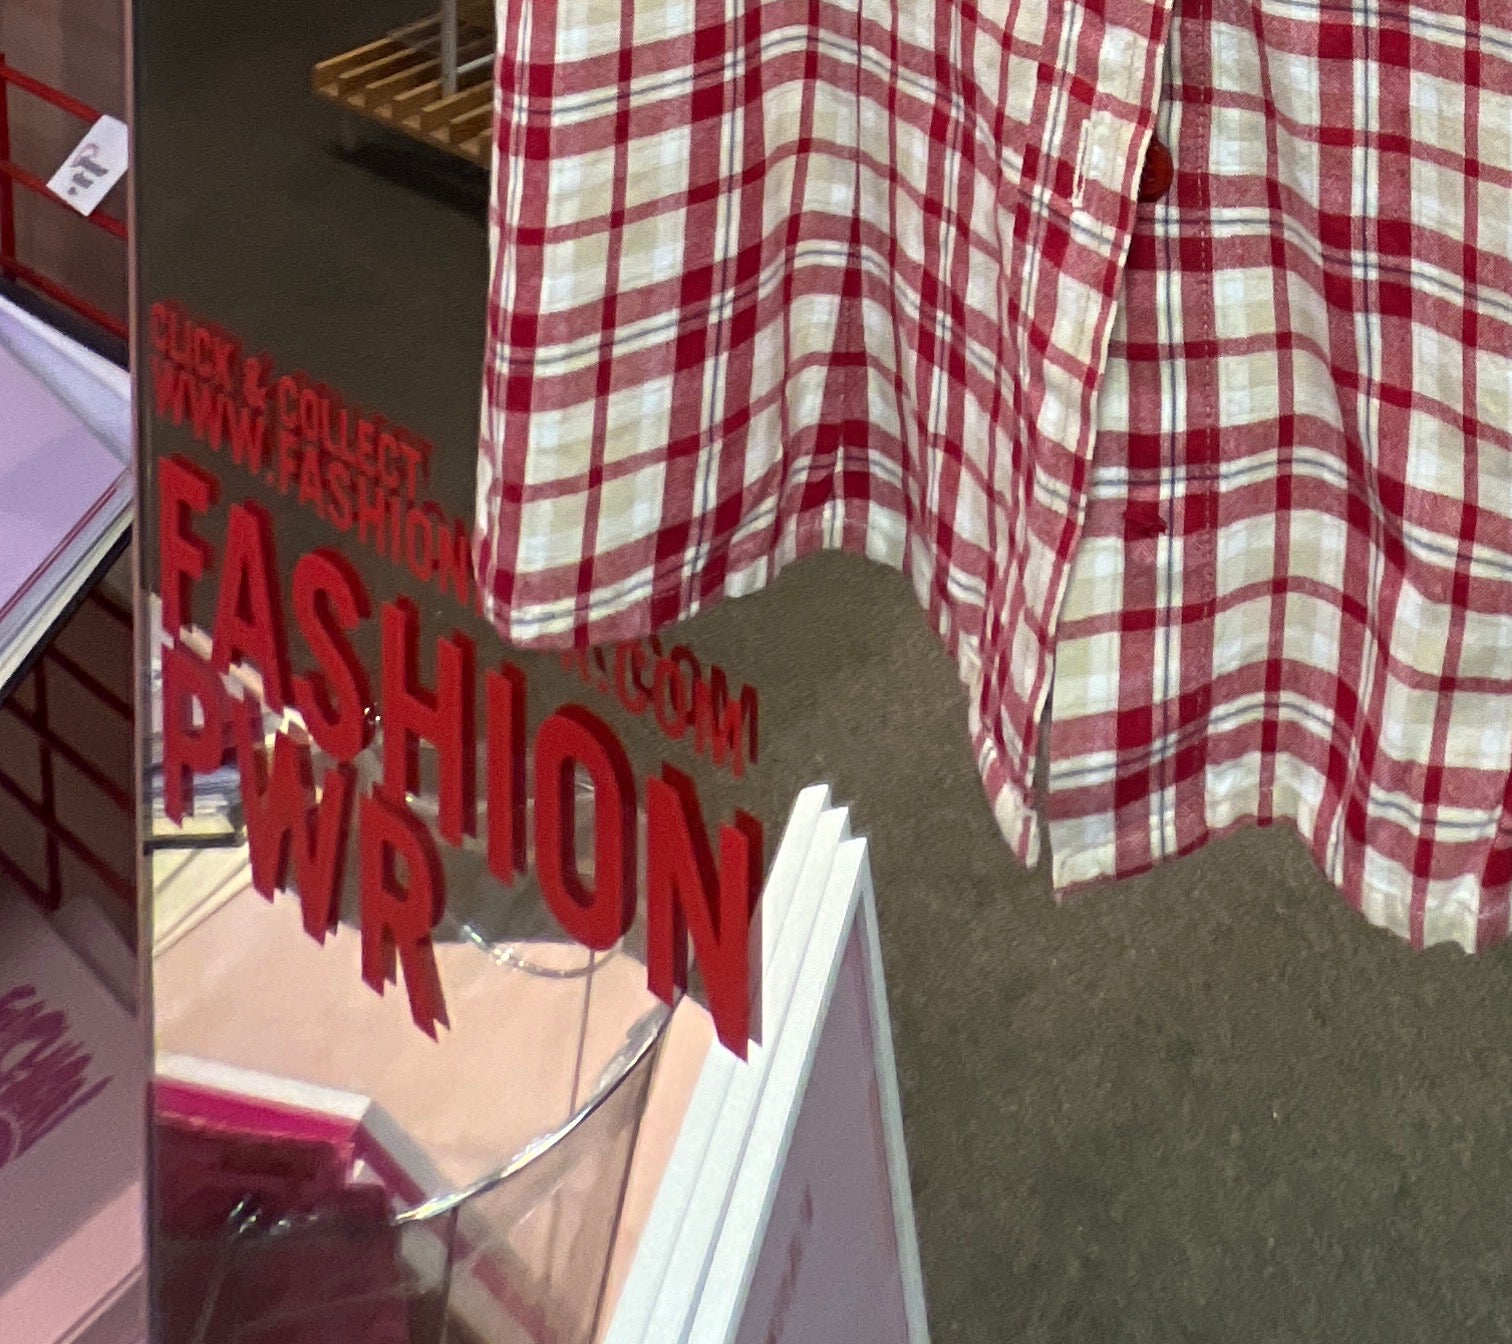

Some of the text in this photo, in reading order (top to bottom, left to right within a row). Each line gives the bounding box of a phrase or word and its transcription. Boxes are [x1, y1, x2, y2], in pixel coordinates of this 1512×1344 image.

[151, 302, 421, 502] CLICK & COLLECT
[158, 456, 750, 1062] FASHION
[161, 647, 440, 1043] PWR
